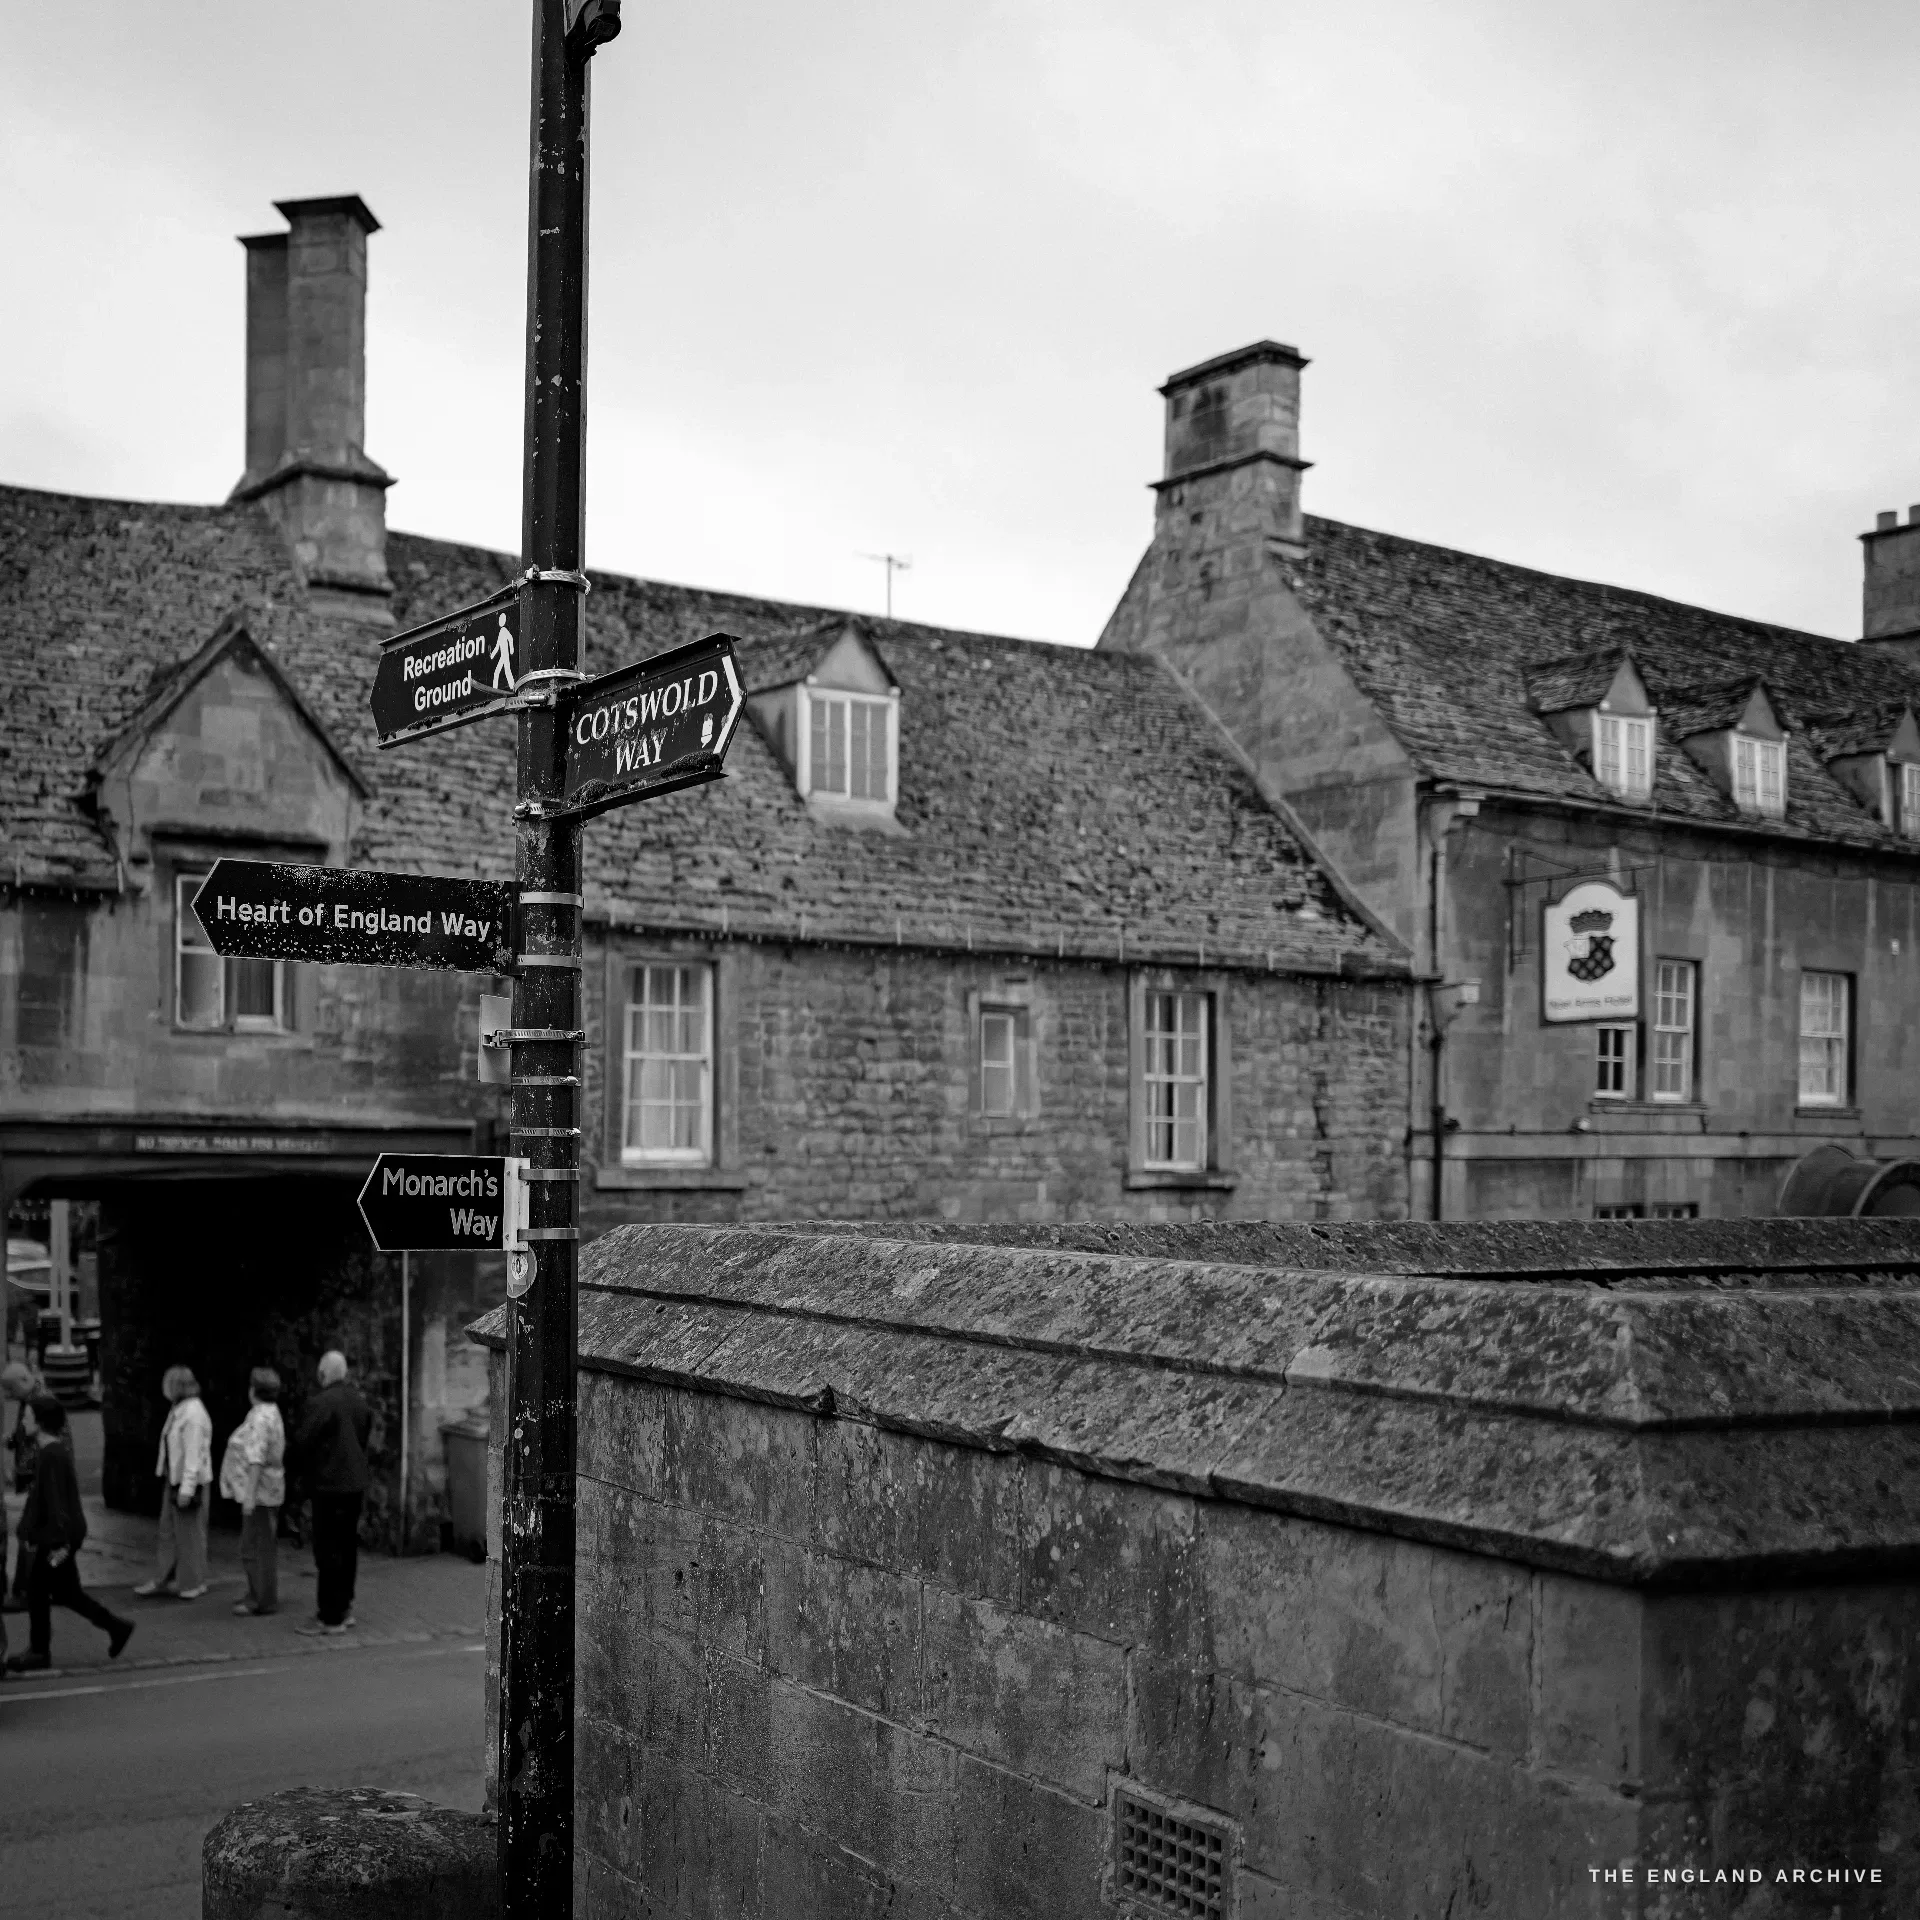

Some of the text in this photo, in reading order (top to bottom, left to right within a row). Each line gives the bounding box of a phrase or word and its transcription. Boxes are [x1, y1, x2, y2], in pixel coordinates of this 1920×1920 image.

[403, 634, 486, 682] Recreation
[414, 669, 472, 711] Ground
[576, 670, 718, 745] COTSWOLD
[614, 726, 668, 775] WAY
[217, 895, 490, 943] Heart of England Way
[382, 1167, 498, 1197] Monarch's
[449, 1208, 498, 1241] Way
